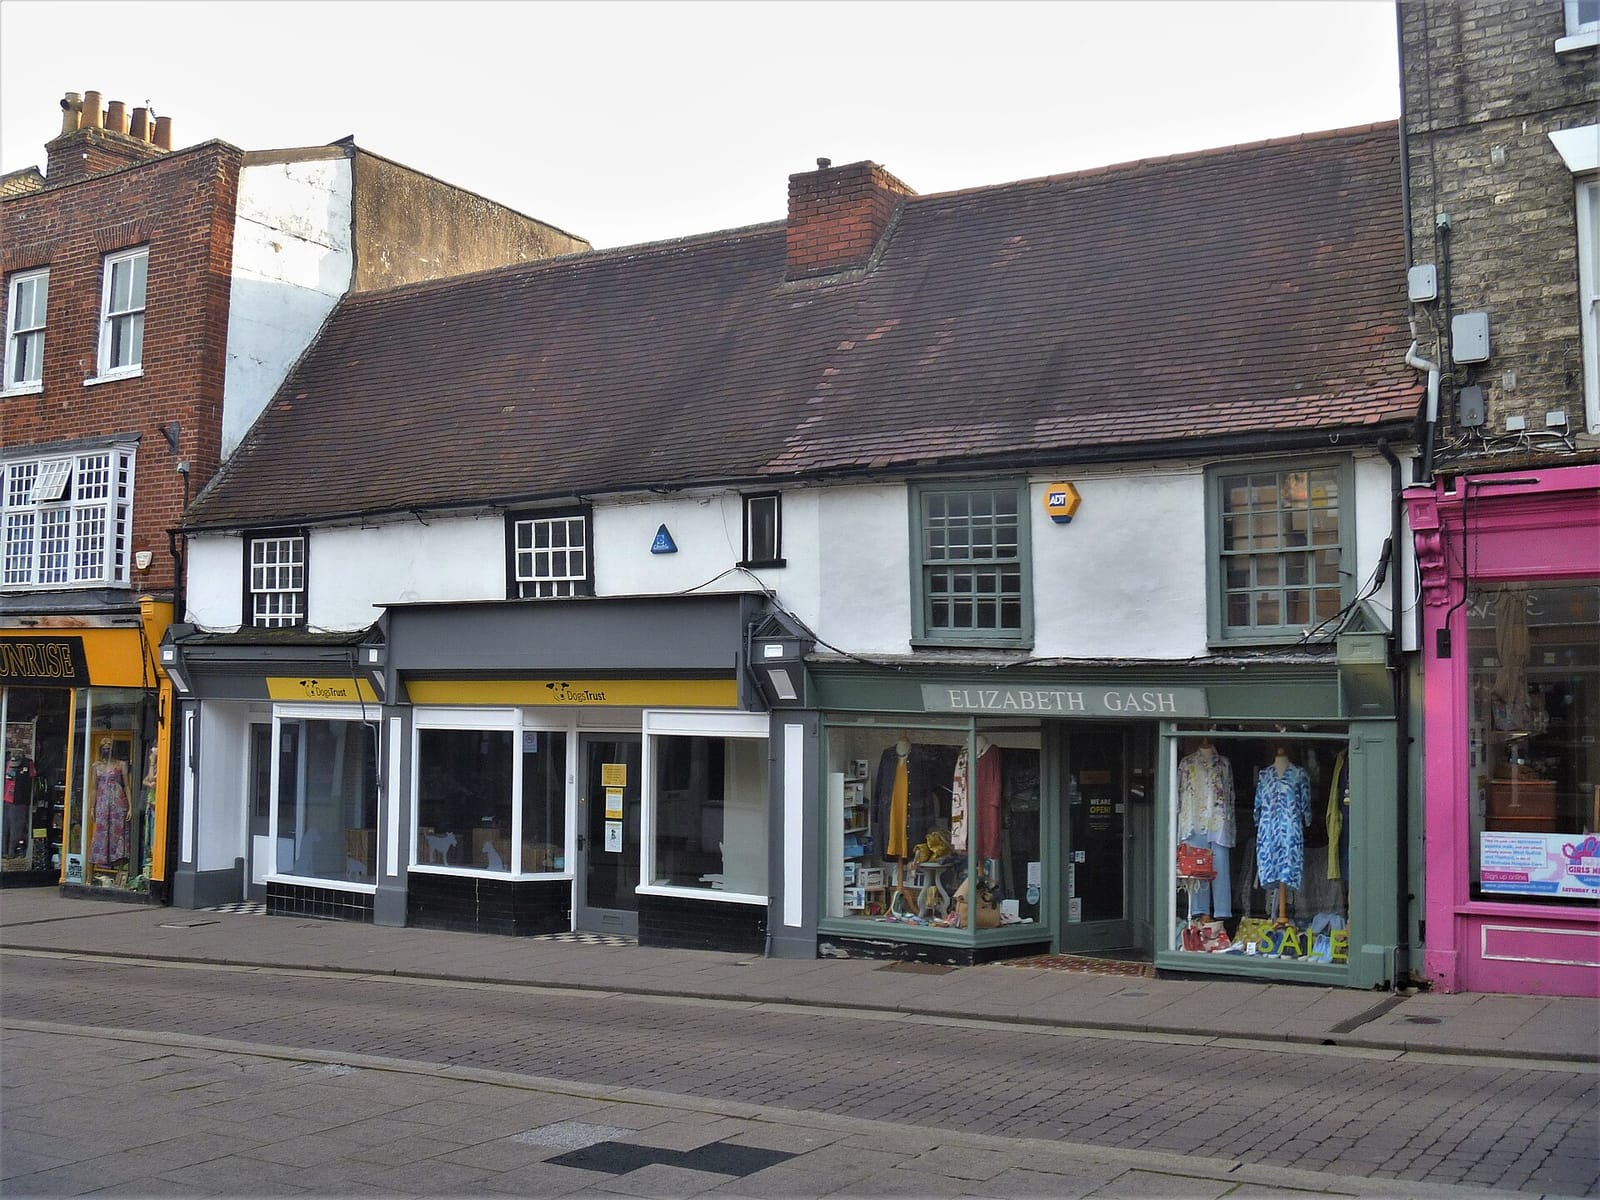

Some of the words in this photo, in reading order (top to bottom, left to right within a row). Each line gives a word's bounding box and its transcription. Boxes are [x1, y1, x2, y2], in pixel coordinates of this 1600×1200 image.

[1049, 494, 1066, 505] ADT
[948, 690, 1086, 711] ELIZABETH
[1103, 691, 1177, 713] GASH
[1568, 866, 1590, 874] GIRLS
[1258, 924, 1348, 959] SALE
